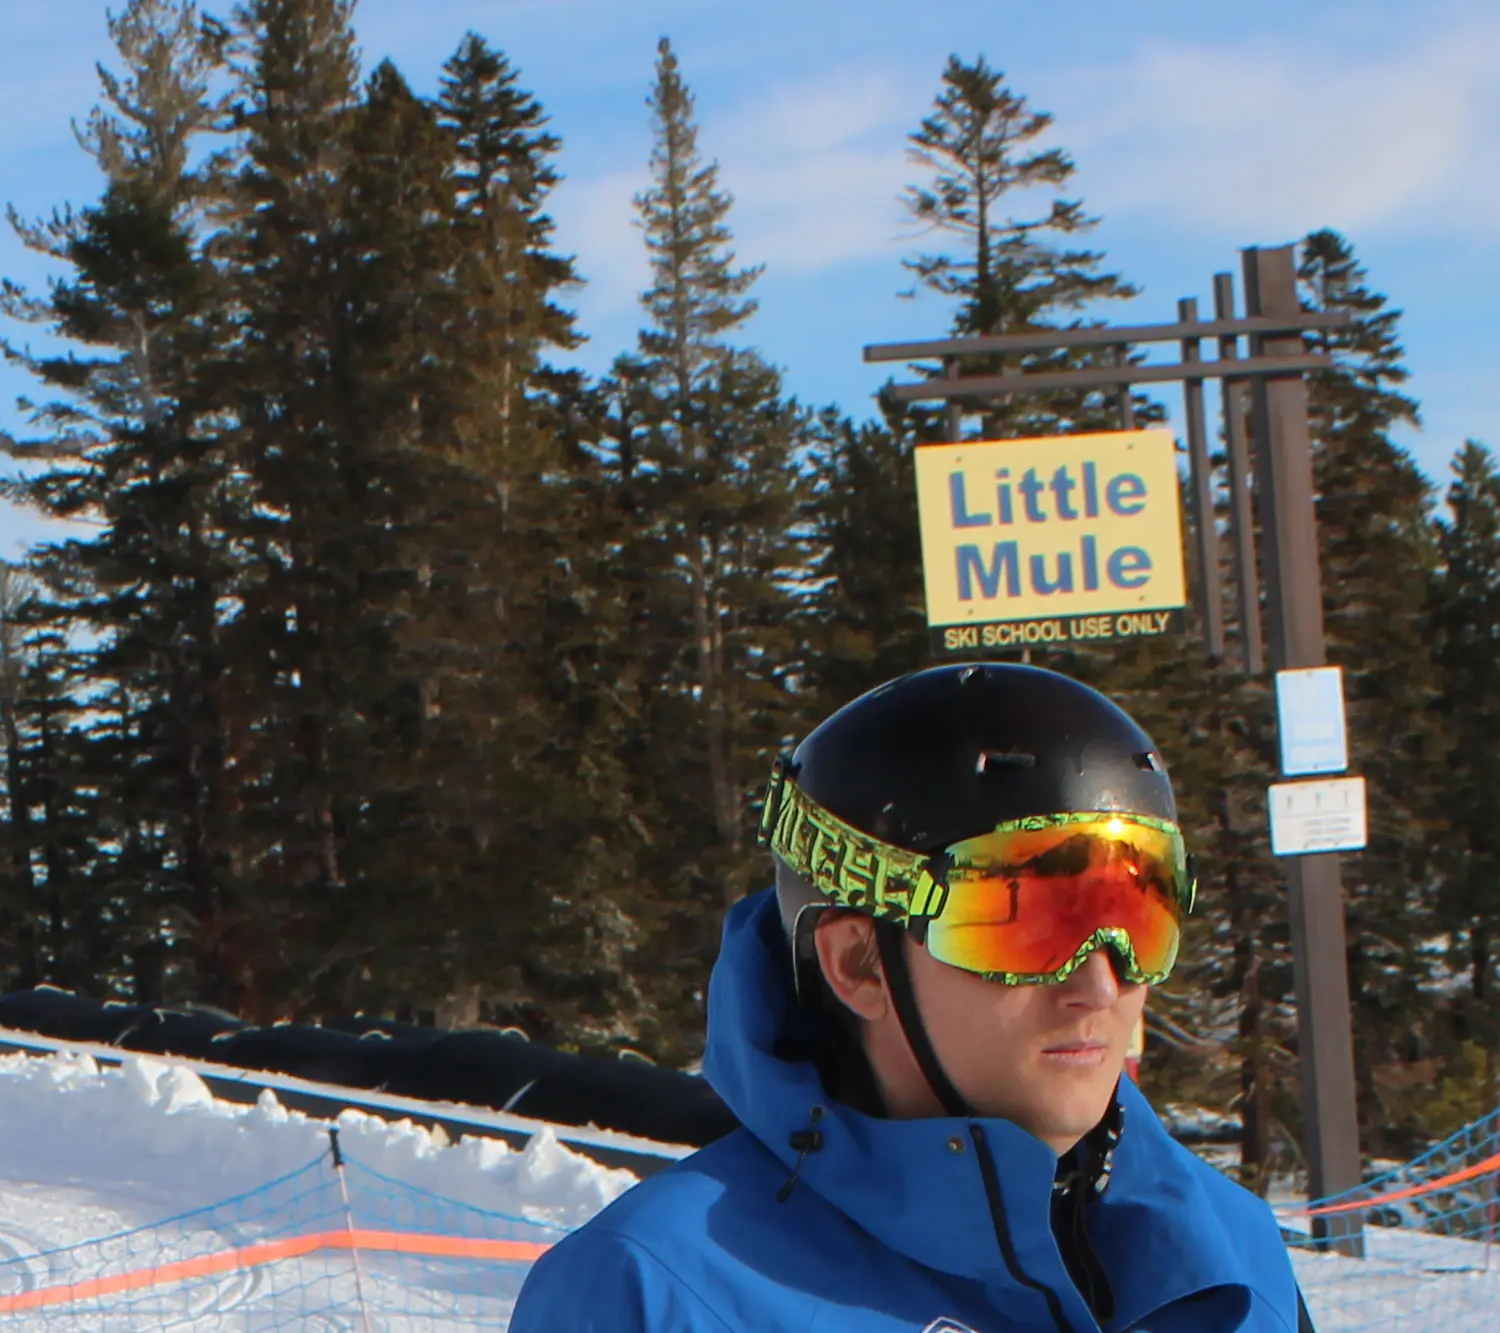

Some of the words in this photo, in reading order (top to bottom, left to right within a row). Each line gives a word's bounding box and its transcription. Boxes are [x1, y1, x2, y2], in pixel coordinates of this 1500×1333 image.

[948, 460, 1148, 528] Little
[954, 534, 1154, 602] Mule
[944, 625, 978, 650] SKI
[982, 619, 1069, 647] SCHOOL
[1071, 615, 1113, 639] USE
[1116, 612, 1171, 637] ONLY
